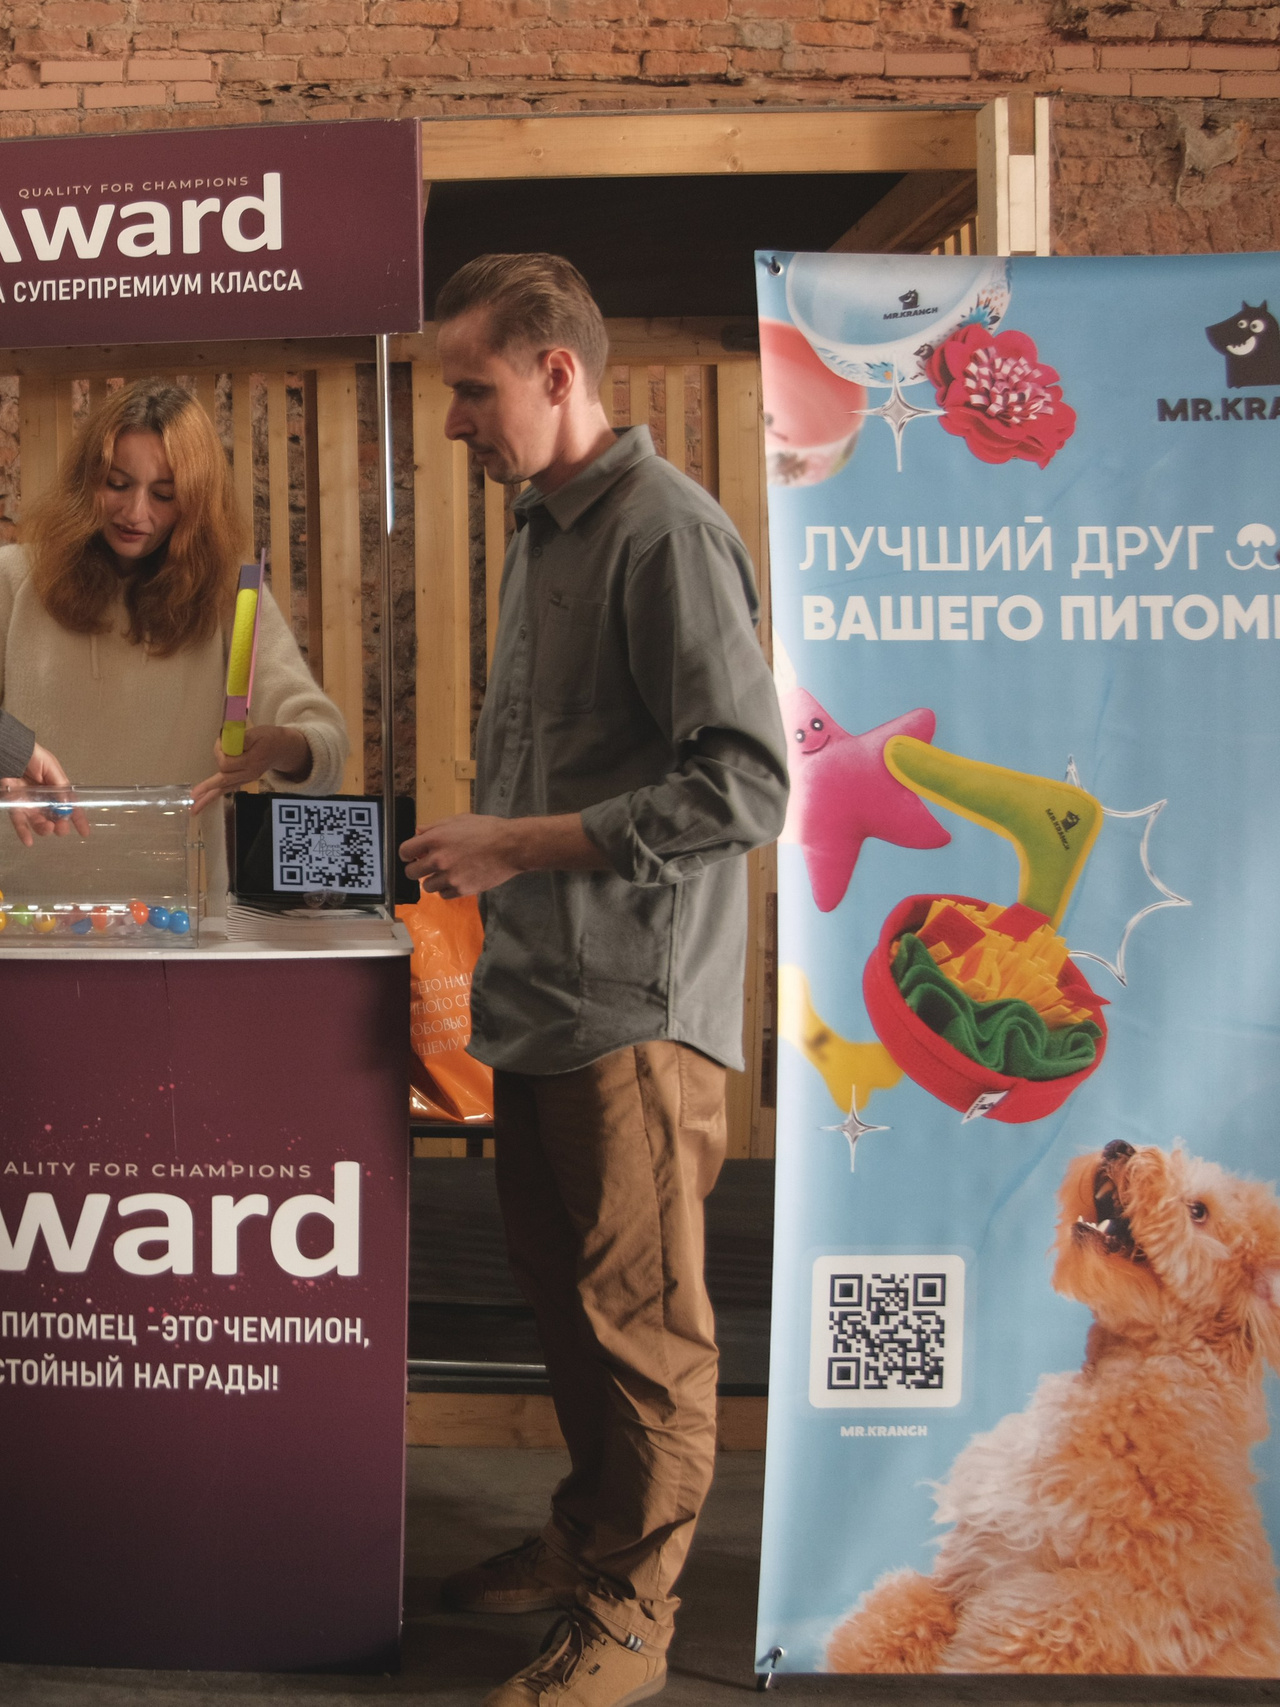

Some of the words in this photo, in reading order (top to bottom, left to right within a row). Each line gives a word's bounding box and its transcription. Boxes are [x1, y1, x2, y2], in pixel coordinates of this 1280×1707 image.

[18, 184, 94, 199] QUALITY
[100, 182, 136, 195] FOR
[142, 176, 250, 192] CHAMPIONS
[13, 273, 202, 304] СУПЕРПРЕМИУМ
[210, 269, 303, 295] КЛАССА
[882, 306, 939, 321] MR.KRANCH
[799, 515, 1053, 572] ЛУЧШИЙ
[1071, 525, 1214, 579] ДРУГ
[802, 594, 1044, 642] ВАШЕГО
[1060, 593, 1280, 642] ПИТОМ
[416, 1037, 459, 1055] ШЕМУ
[88, 1162, 140, 1178] FOR
[151, 1163, 313, 1179] CHAMPIONS
[2, 1311, 137, 1345] ПИТОМЕЦ
[223, 1316, 370, 1349] ЧЕМПИОН,
[134, 1362, 280, 1395] НАГРАДЫ!
[840, 1425, 928, 1438] MR.KRANCH
